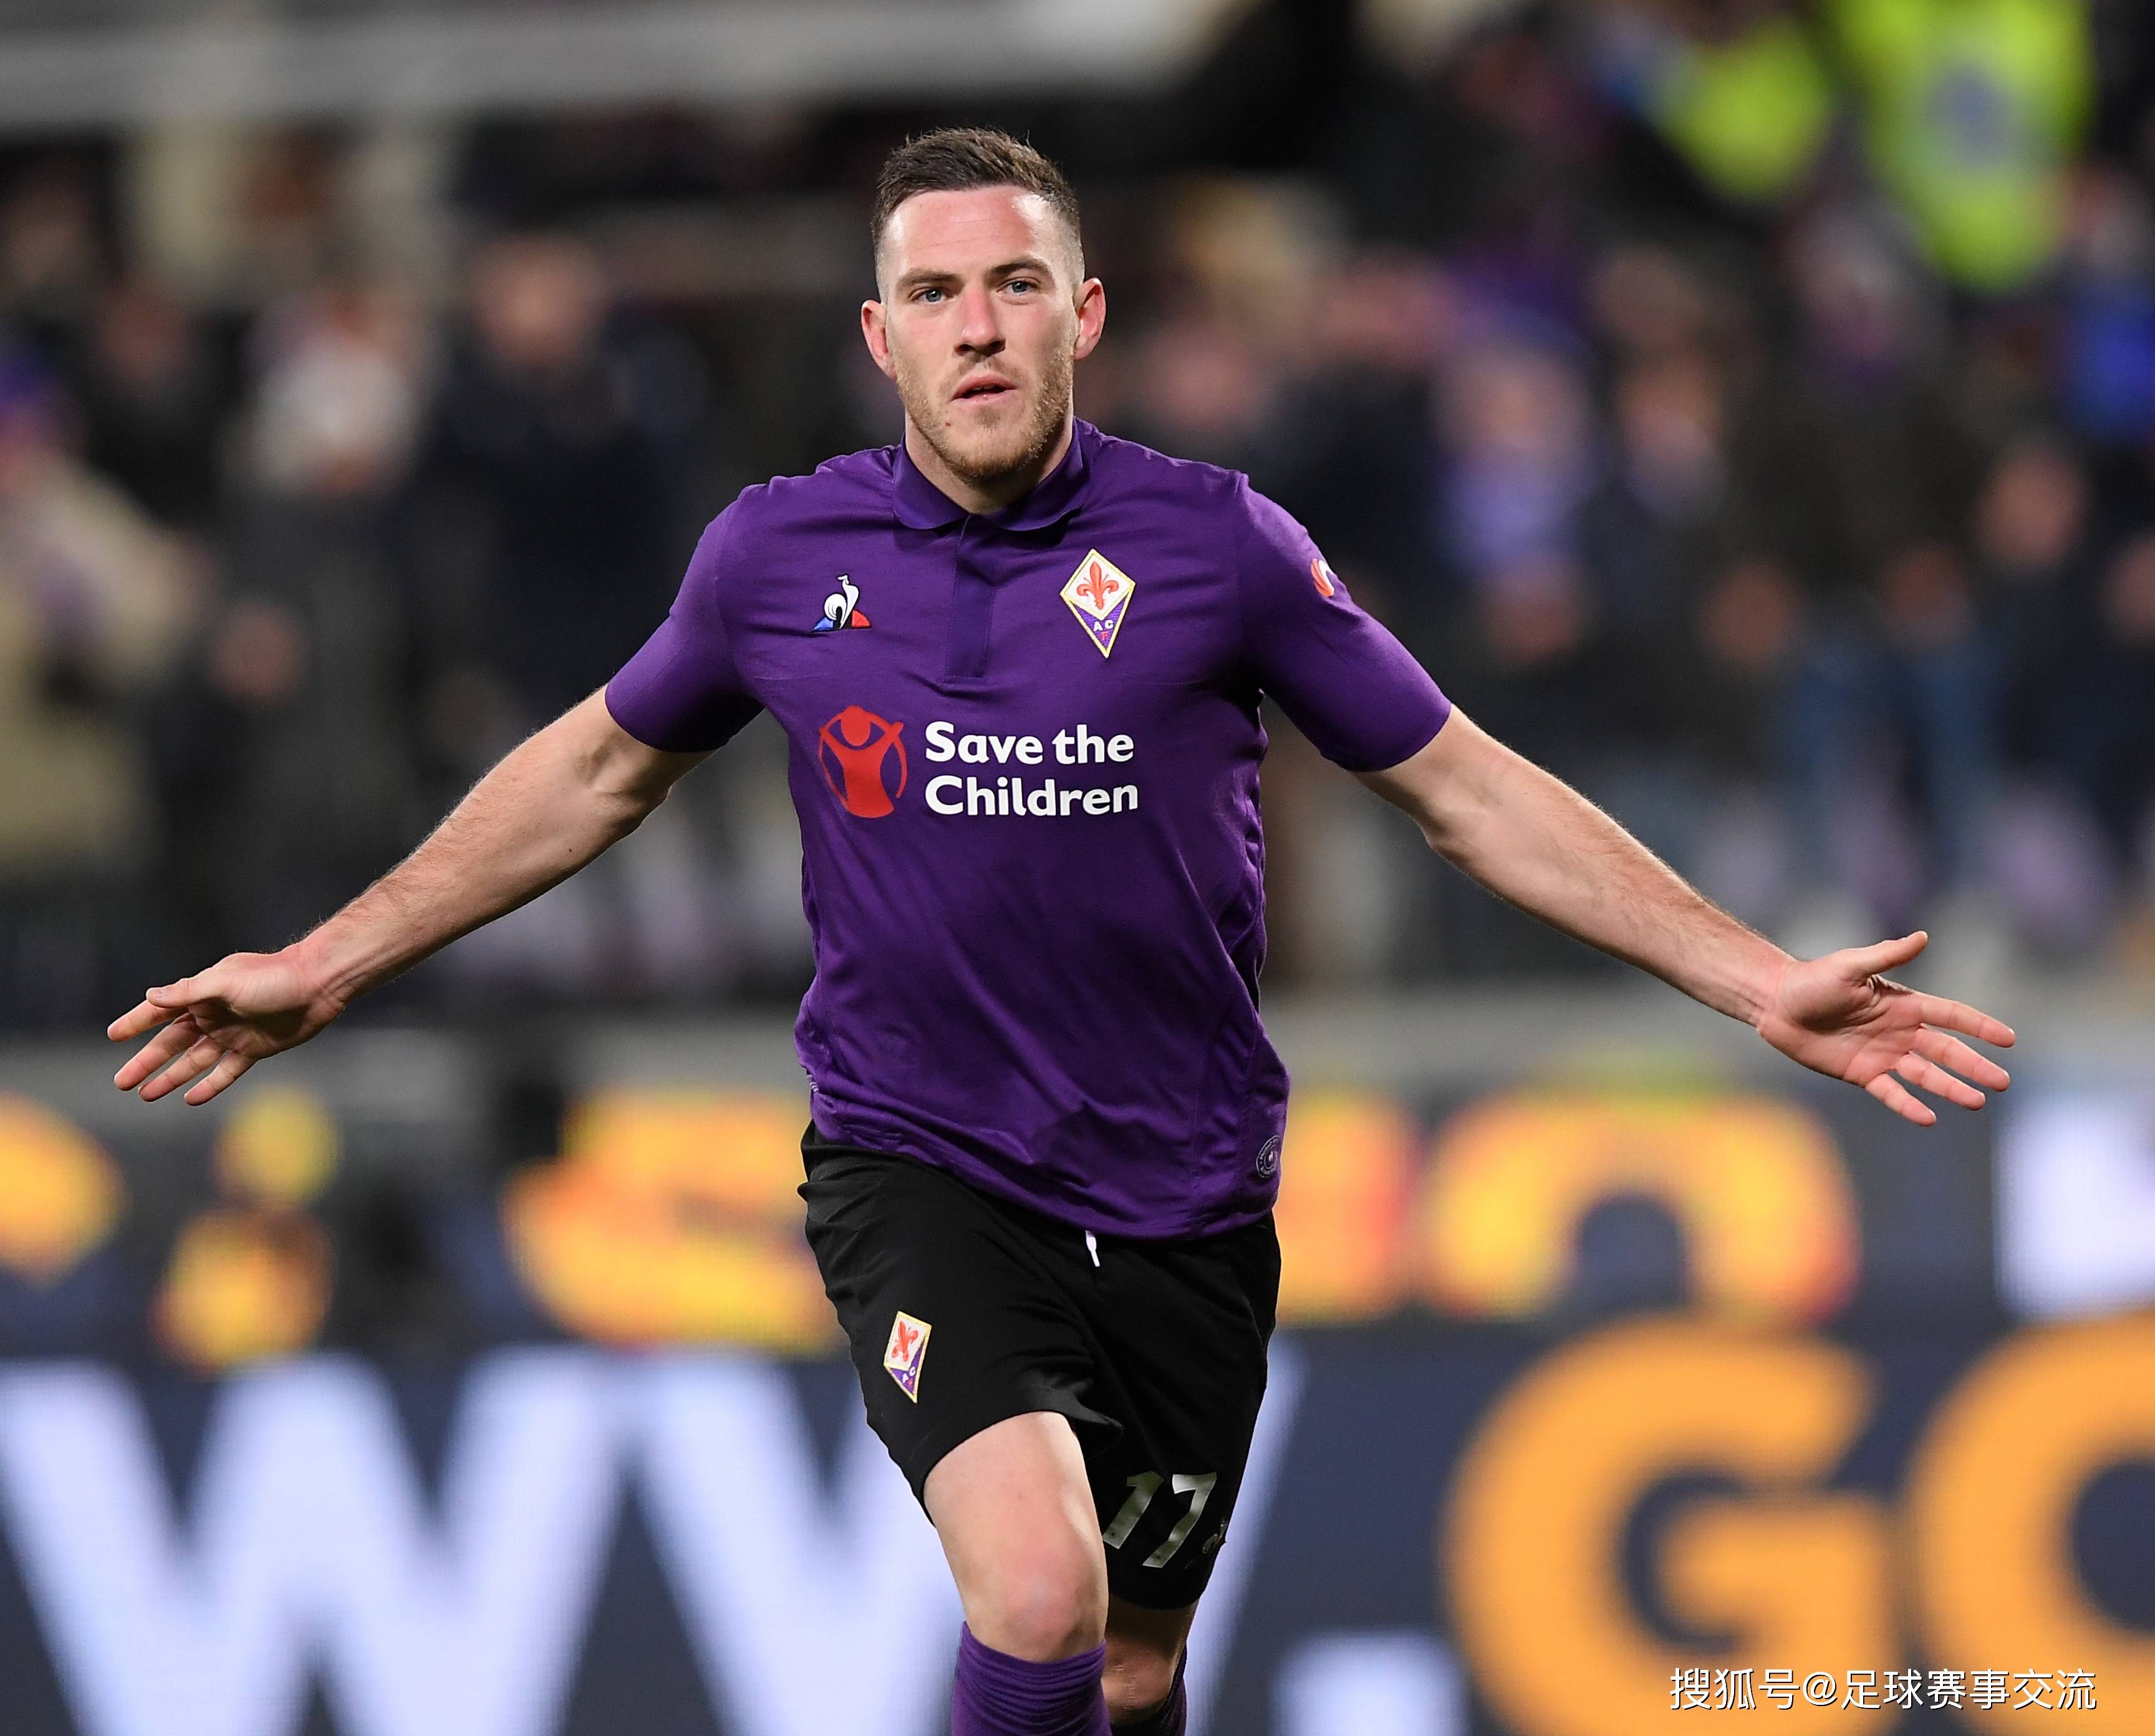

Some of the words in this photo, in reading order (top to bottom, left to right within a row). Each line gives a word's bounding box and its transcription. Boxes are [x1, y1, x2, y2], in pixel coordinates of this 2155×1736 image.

[925, 721, 1043, 765] Save
[1052, 724, 1134, 765] the
[925, 774, 1139, 816] Children
[1102, 1470, 1218, 1569] 17
